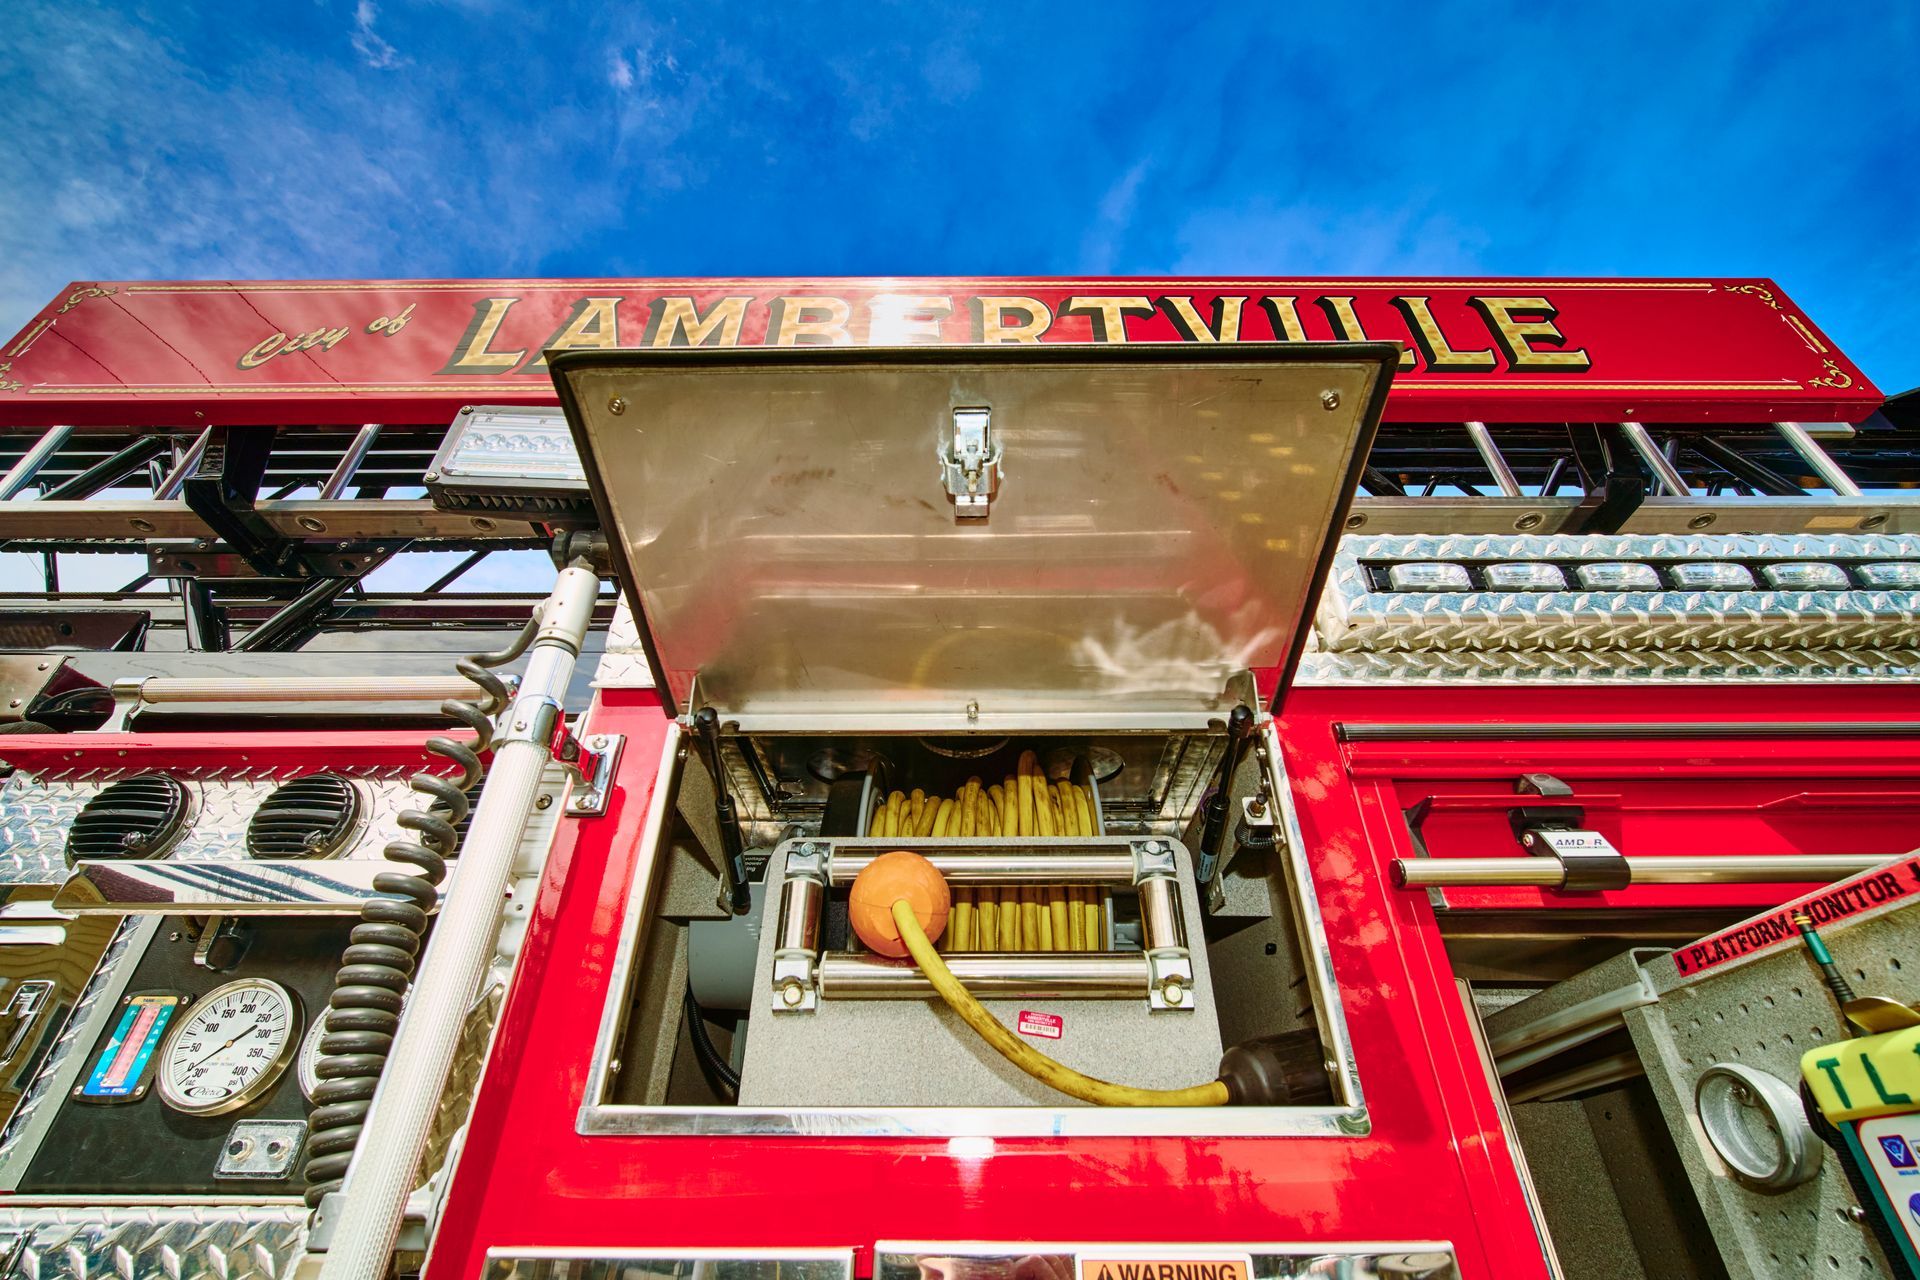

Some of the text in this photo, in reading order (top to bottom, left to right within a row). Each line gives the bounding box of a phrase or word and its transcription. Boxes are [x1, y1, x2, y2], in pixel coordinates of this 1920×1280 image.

[238, 302, 417, 369] City of
[433, 296, 1592, 376] LAMBERTVILLE
[1690, 914, 1794, 968] PLATFORM
[221, 1009, 236, 1018] 150
[240, 1004, 257, 1013] 200
[255, 1013, 272, 1023] 250
[204, 1023, 220, 1033] 100
[255, 1029, 272, 1039] 300
[190, 1042, 202, 1052] 50
[247, 1048, 264, 1058] 350
[187, 1062, 195, 1072] 0
[232, 1066, 249, 1076] 400
[1816, 1042, 1920, 1110] TL
[1117, 1263, 1237, 1280] WARNING
